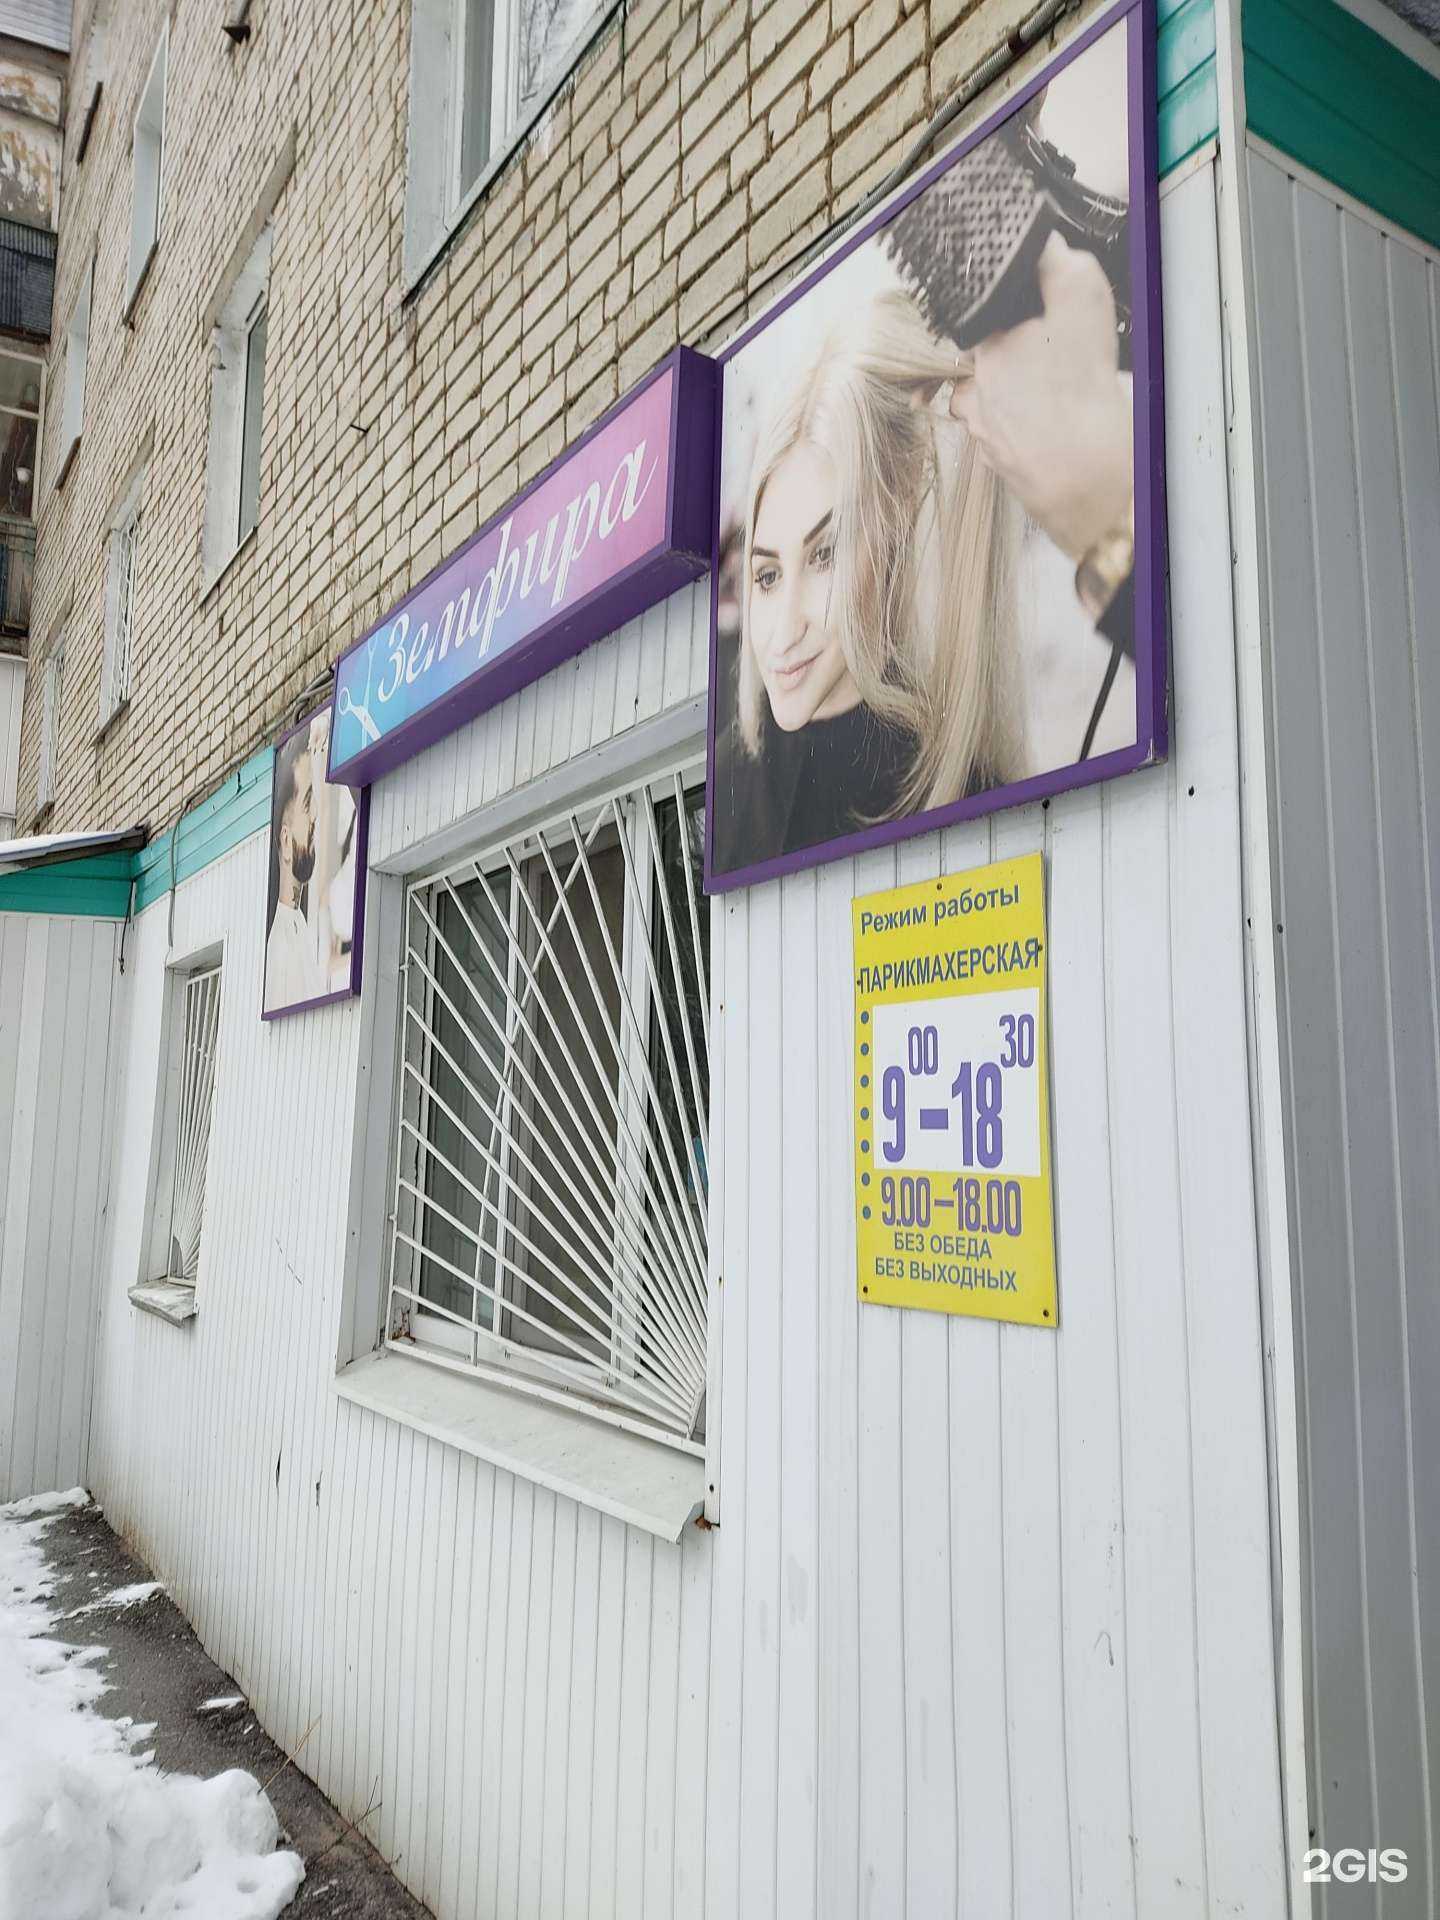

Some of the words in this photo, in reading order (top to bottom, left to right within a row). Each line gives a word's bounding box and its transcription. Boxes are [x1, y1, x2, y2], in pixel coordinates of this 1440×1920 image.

[378, 440, 659, 703] Земфира
[860, 900, 928, 936] Режим
[934, 883, 1020, 926] работы
[859, 937, 1040, 995] ПАРИКМАХЕРСКАЯ
[999, 1013, 1035, 1069] 30
[893, 1231, 927, 1253] БЕЗ
[930, 1234, 993, 1260] ОБЕДА
[875, 1257, 905, 1279] БЕЗ
[910, 1261, 1018, 1293] ВЫХОДНЫХ
